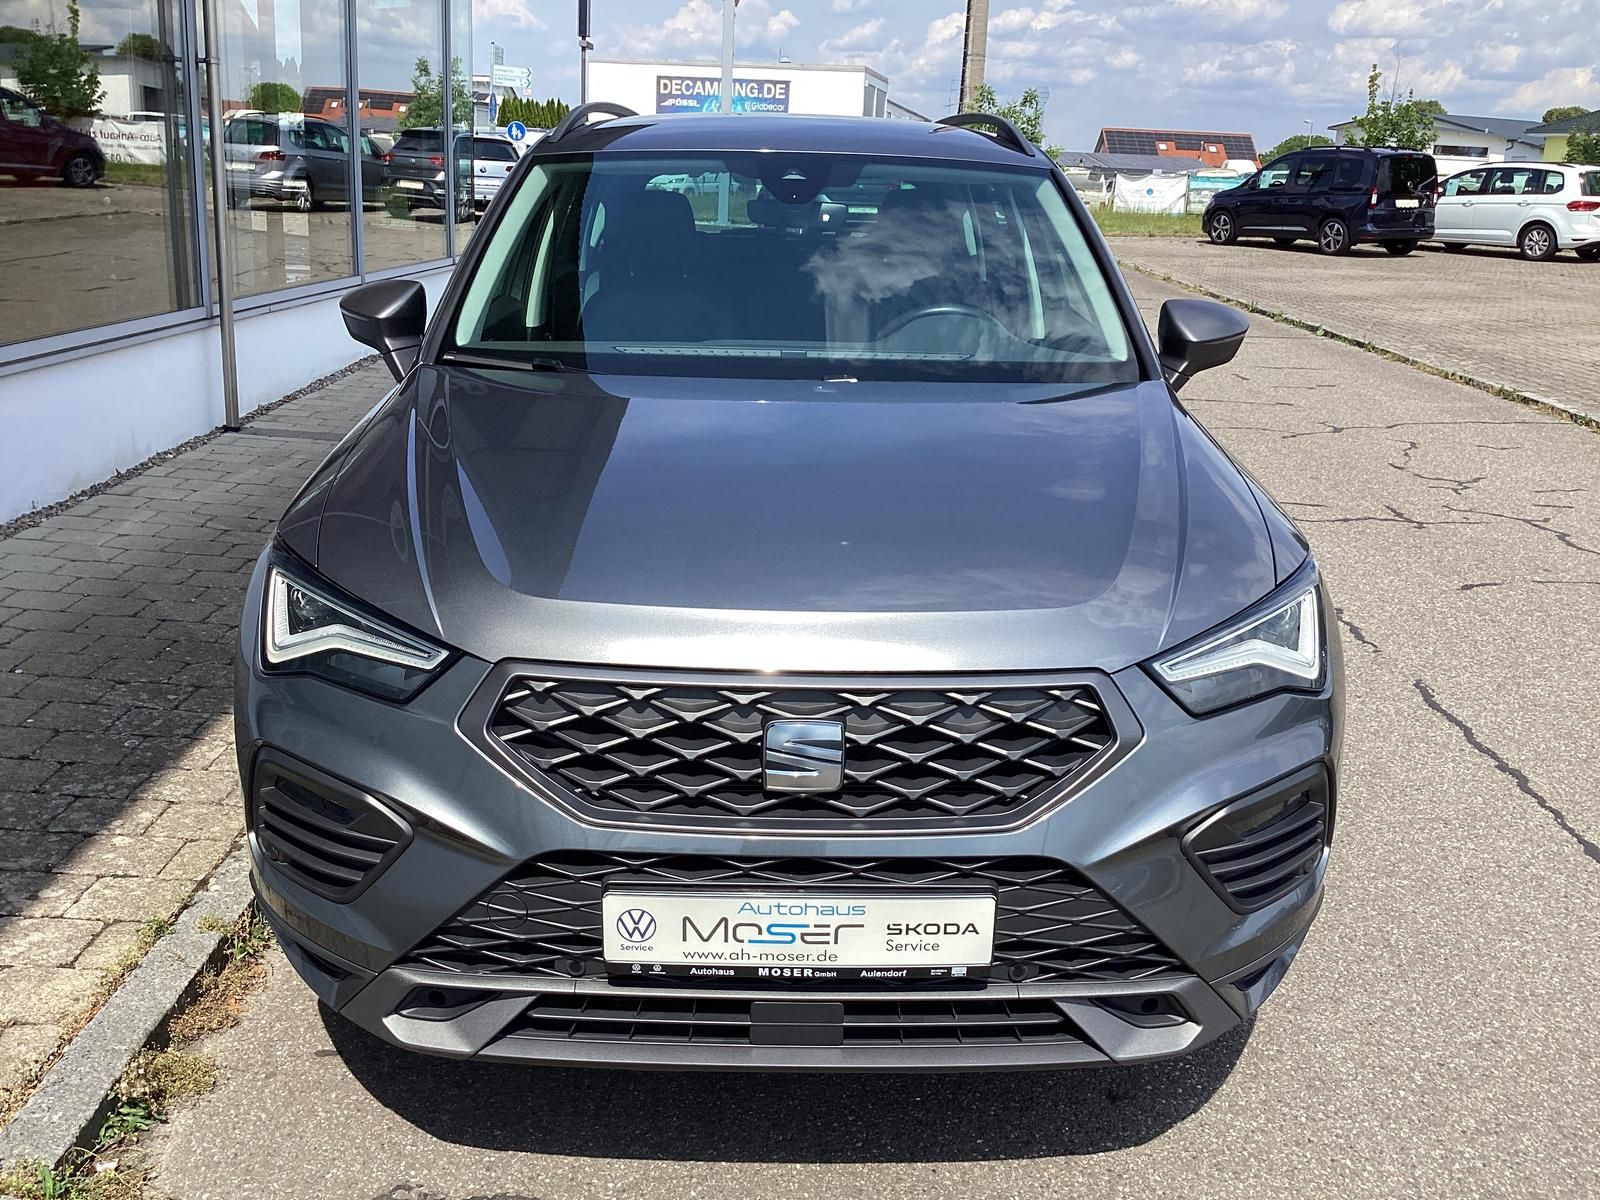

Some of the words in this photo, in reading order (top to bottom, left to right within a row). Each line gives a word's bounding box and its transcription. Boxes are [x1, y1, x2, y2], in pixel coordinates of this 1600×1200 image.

[659, 79, 786, 99] DECAMING.DE
[737, 901, 867, 916] Autohaus
[620, 943, 654, 952] Service
[885, 938, 940, 952] Service
[682, 947, 838, 962] www.ah-moser.de
[690, 967, 735, 976] Autohaus
[758, 967, 813, 977] MOSER
[860, 969, 908, 977] Aulendorf
